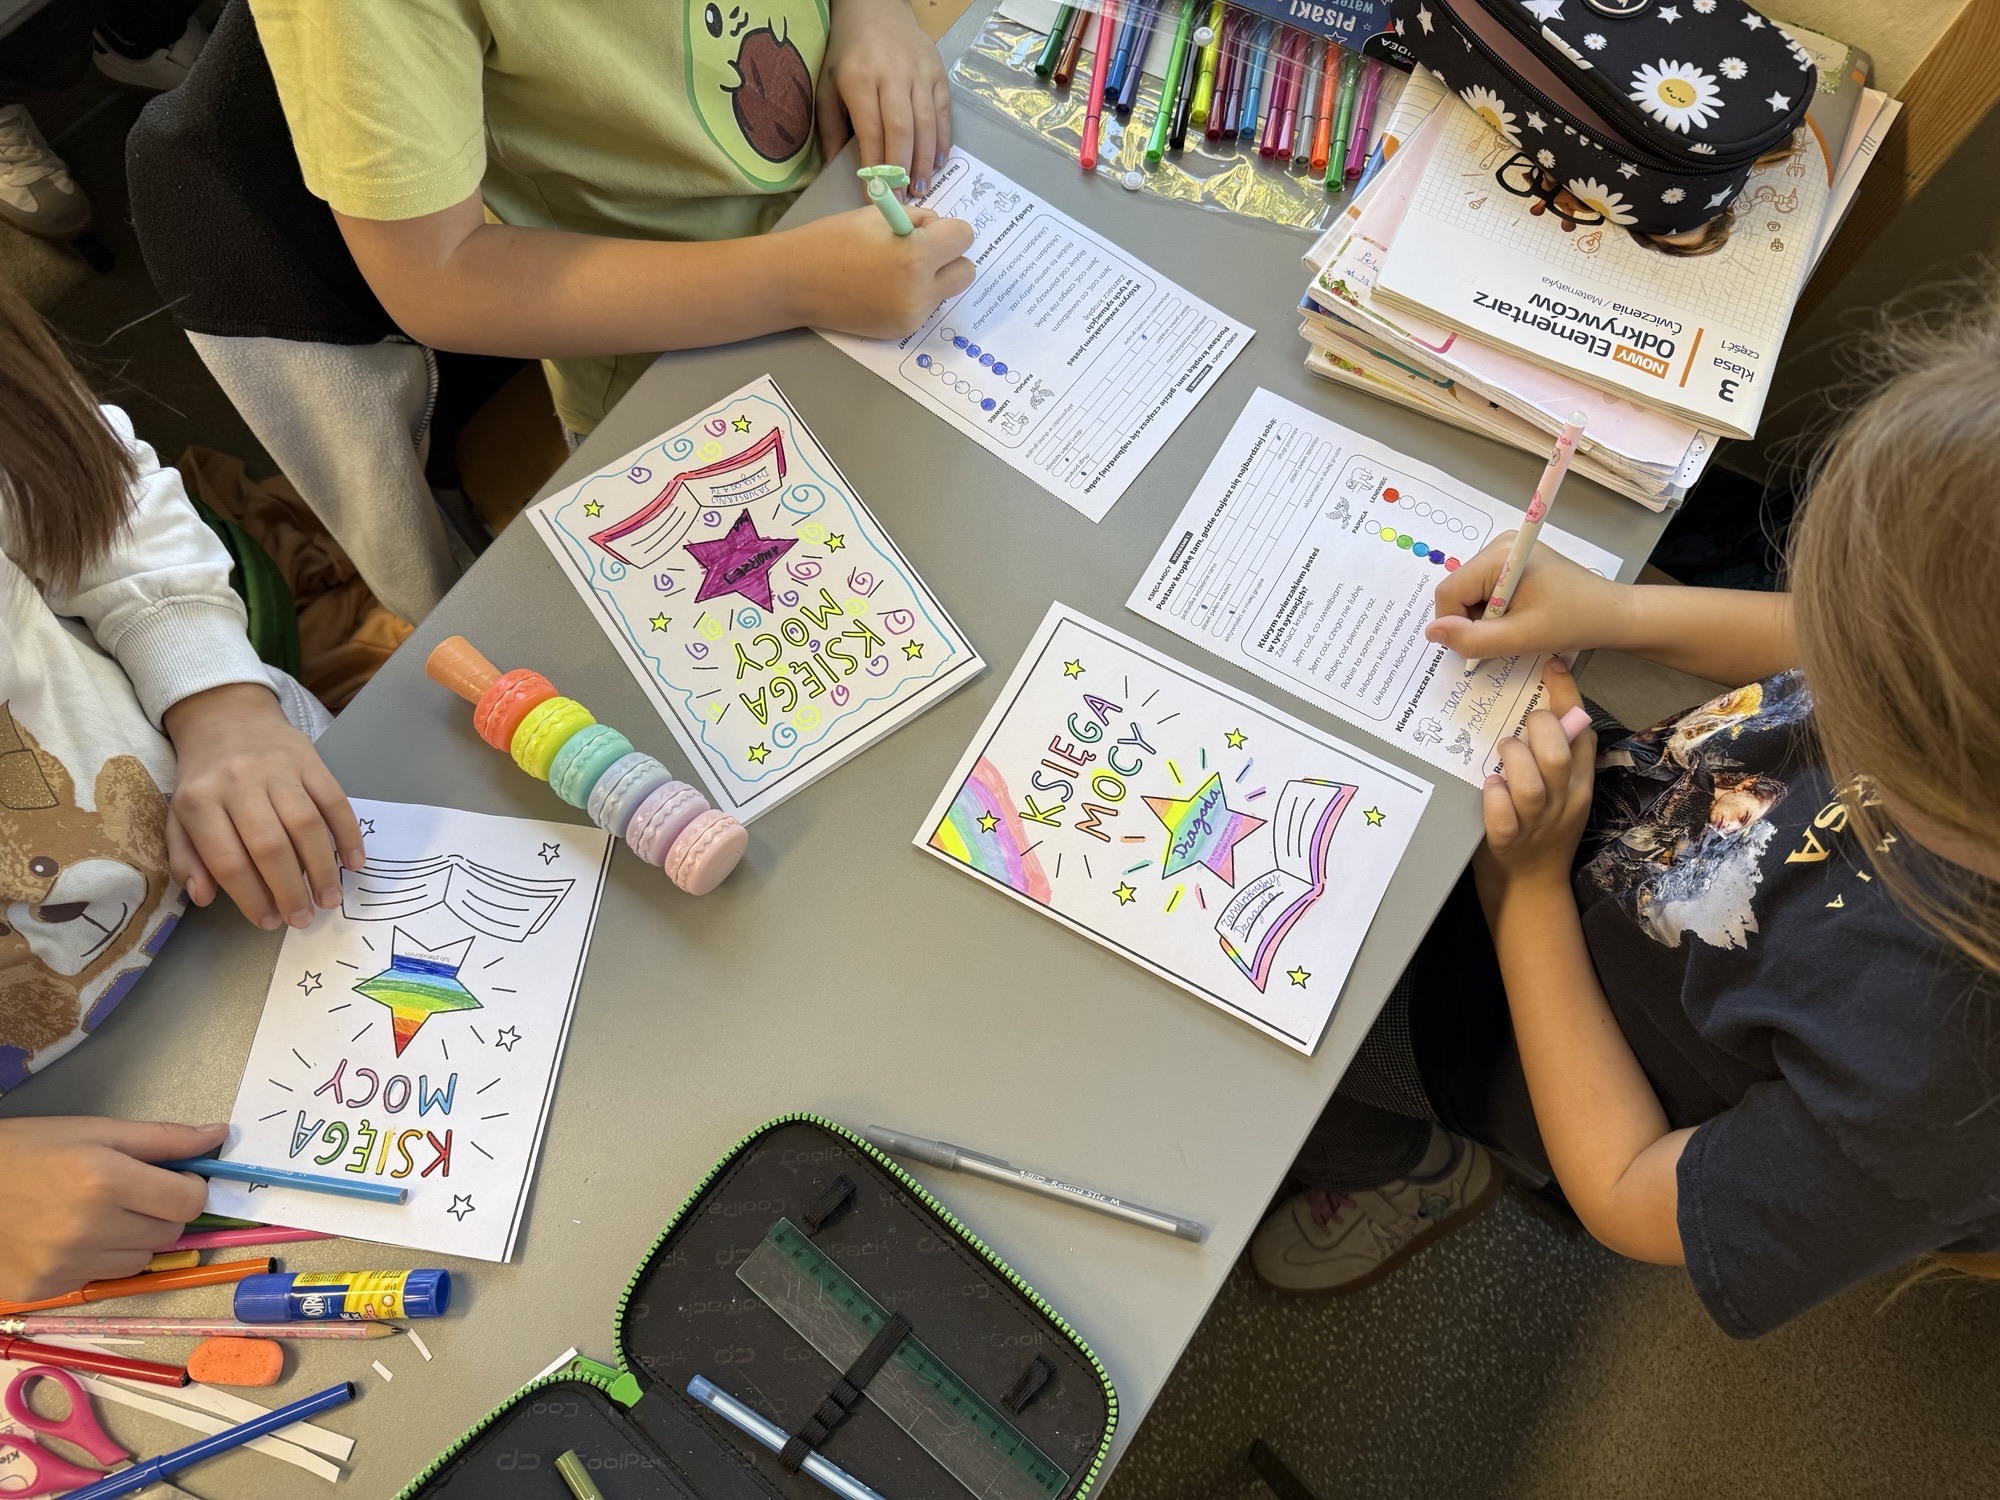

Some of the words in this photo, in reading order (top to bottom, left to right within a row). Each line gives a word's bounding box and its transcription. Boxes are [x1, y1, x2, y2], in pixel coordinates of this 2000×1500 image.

[1381, 37, 1416, 59] IDEA
[946, 163, 960, 178] Raz
[925, 173, 949, 200] jestem
[1013, 201, 1034, 223] Kiedy
[992, 219, 1018, 247] jeszcze
[1020, 224, 1048, 255] Układam
[974, 243, 996, 266] jesteś
[1033, 232, 1061, 263] Układam
[1067, 247, 1086, 268] Robię
[996, 269, 1007, 280] po
[1004, 252, 1024, 273] klocki
[1017, 260, 1036, 281] klocki
[1033, 265, 1051, 284] samo
[1048, 258, 1058, 267] to
[1058, 265, 1071, 279] coś
[1084, 255, 1100, 272] Jem
[1097, 264, 1112, 280] Jem
[1073, 269, 1088, 285] coś,
[1086, 277, 1100, 293] coś,
[1101, 273, 1126, 300] Zaznacz
[1124, 277, 1133, 287] w
[970, 277, 1000, 309] swojemu.
[995, 276, 1020, 304] według
[1017, 281, 1036, 302] setny
[1033, 275, 1061, 305] pierwszy
[1056, 281, 1076, 302] czego
[1079, 290, 1088, 300] co
[1111, 283, 1128, 302] tych
[1116, 282, 1141, 309] Którym
[1539, 274, 1604, 306] Matematyka
[969, 299, 999, 332] instrukcji.
[1007, 299, 1020, 313] raz.
[1024, 302, 1037, 316] raz.
[1048, 300, 1060, 313] nie
[1049, 298, 1082, 334] uwielbiam.
[1080, 297, 1104, 323] kropkę.
[1032, 310, 1051, 330] lubię.
[1082, 306, 1121, 348] zwierzakiem
[1467, 289, 1615, 358] Elementarz
[1523, 290, 1678, 360] Odkrywców
[1609, 301, 1683, 337] Ćwiczenia
[1206, 325, 1230, 351] Postaw
[1065, 344, 1087, 367] jesteś
[1186, 348, 1209, 374] kropkę
[1614, 346, 1665, 375] NOWY
[1173, 372, 1189, 389] tam,
[1710, 355, 1756, 382] klasa
[1013, 372, 1033, 394] PAPUGA
[1715, 377, 1740, 403] 3
[1158, 386, 1177, 407] gdzie
[986, 398, 1010, 424] LENIWIEC
[1137, 404, 1163, 432] czujesz
[1128, 428, 1141, 442] się
[1097, 438, 1134, 478] najbardziej
[1081, 474, 1102, 496] sobą:
[1155, 580, 1177, 610] Postaw
[1172, 553, 1194, 582] kropkę
[1189, 536, 1205, 555] tam,
[1199, 516, 1218, 538] gdzie
[1212, 488, 1235, 518] czujesz
[1228, 477, 1241, 490] się
[1235, 435, 1266, 479] najbardziej
[1260, 416, 1278, 438] sobą:
[1351, 509, 1369, 534] PAPUGA
[1368, 475, 1388, 503] LENIWIEC
[1146, 580, 1163, 602] KSIĘGA
[1159, 564, 1172, 581] MOCY
[1256, 617, 1280, 649] Którym
[1273, 569, 1308, 619] zwierzakiem
[1301, 546, 1321, 572] jesteś
[1315, 580, 1346, 622] uwielbiam.
[1383, 598, 1396, 613] raz.
[734, 589, 844, 680] MOCY
[1270, 625, 1287, 645] tych
[1274, 625, 1298, 658] Zaznacz
[1291, 597, 1315, 627] kropkę.
[1307, 655, 1323, 674] Jem
[1317, 639, 1332, 656] coś,
[1326, 617, 1346, 641] czego
[1339, 603, 1352, 617] nie
[1346, 582, 1365, 605] lubię.
[1311, 622, 1321, 633] co
[1355, 660, 1383, 698] Układam
[1375, 636, 1395, 661] klocki
[1387, 607, 1411, 638] według
[1403, 571, 1432, 609] instrukcji.
[1370, 612, 1389, 635] setny
[1266, 644, 1275, 653] w
[1301, 631, 1316, 649] coś,
[1323, 657, 1342, 682] Robię
[1336, 643, 1350, 659] coś
[1343, 610, 1370, 645] pierwszy
[1363, 596, 1377, 611] raz.
[1357, 634, 1376, 657] samo
[1291, 647, 1306, 666] Jem
[1353, 656, 1363, 667] to
[739, 620, 885, 726] KSIĘGA
[1371, 668, 1399, 706] Układam
[1391, 645, 1411, 669] klocki
[1405, 633, 1417, 647] po
[1393, 705, 1415, 733] Kiedy
[1406, 674, 1433, 708] jeszcze
[1423, 648, 1447, 676] jesteś
[1019, 693, 1123, 829] KSIĘGA
[1074, 720, 1157, 843] MOCY
[1214, 851, 1224, 862] lub
[1219, 822, 1241, 853] pseudonim
[1217, 826, 1230, 843] swoje
[1206, 855, 1214, 863] tu
[1209, 841, 1223, 857] wpisz
[403, 948, 439, 962] pseudonim
[439, 955, 450, 964] lub
[314, 1058, 458, 1117] MOCY
[289, 1109, 453, 1178] KSIĘGA
[1050, 1179, 1084, 1195] Round
[1086, 1190, 1106, 1201] Stic
[1110, 1198, 1120, 1206] M
